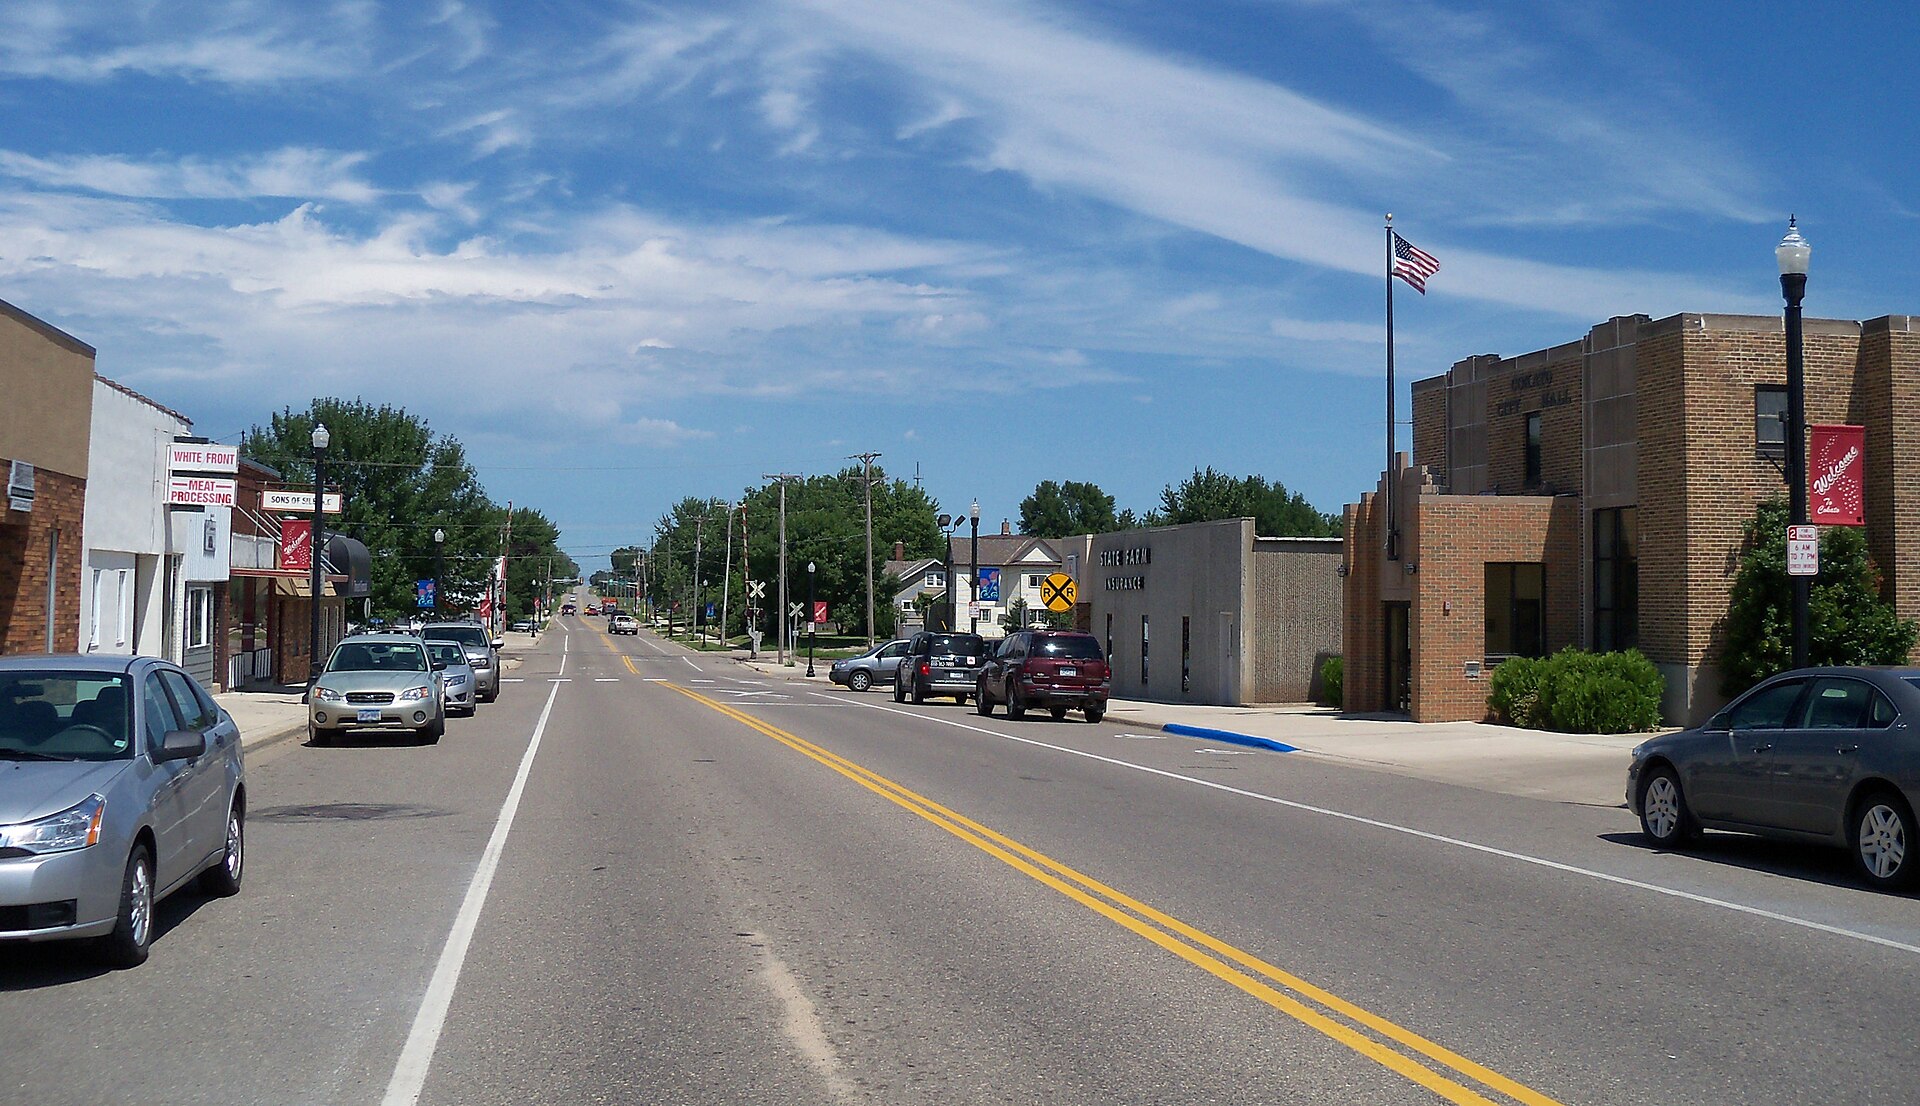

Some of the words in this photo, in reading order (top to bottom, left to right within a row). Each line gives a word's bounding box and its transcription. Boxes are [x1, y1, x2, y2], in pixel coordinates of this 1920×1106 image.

[174, 451, 202, 463] WHITE
[206, 453, 235, 465] FRONT
[1813, 446, 1858, 495] Welcome
[188, 480, 216, 492] MEAT
[171, 491, 232, 504] PROCESSING
[271, 495, 290, 504] SONS
[291, 496, 300, 504] OF
[1789, 529, 1796, 539] 2
[1100, 550, 1121, 567] STATE
[1125, 547, 1149, 565] FARM
[1800, 552, 1805, 560] 7
[1806, 552, 1815, 560] PM
[1104, 576, 1142, 591] INSURANCE
[1043, 587, 1051, 598] R
[1066, 587, 1075, 597] R
